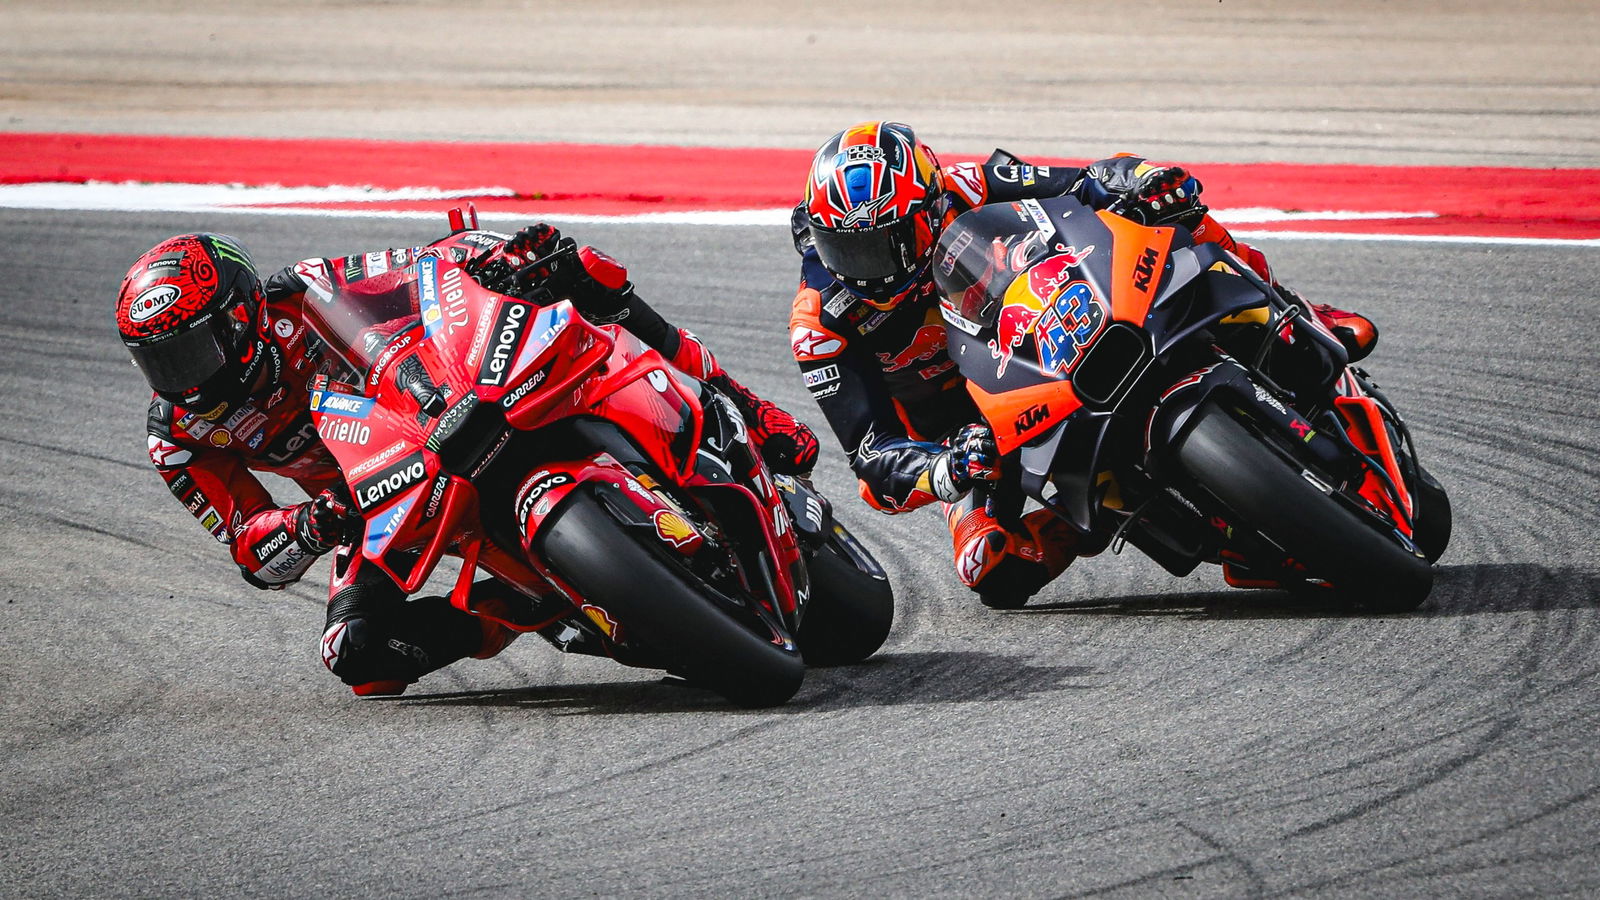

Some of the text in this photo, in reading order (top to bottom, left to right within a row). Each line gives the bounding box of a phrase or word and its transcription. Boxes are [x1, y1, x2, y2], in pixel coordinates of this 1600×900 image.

[149, 260, 177, 269] Lenovo
[884, 276, 895, 284] CAT
[1132, 248, 1159, 293] KTM
[442, 267, 467, 318] riello
[286, 325, 305, 350] motorola
[467, 296, 497, 366] FRECCIAROSSA
[481, 304, 525, 385] Lenovo
[540, 318, 567, 342] TIM
[1034, 282, 1106, 377] 43
[370, 336, 411, 386] VARGROUP
[322, 396, 363, 413] ADVANCE
[503, 370, 546, 408] CARRERA
[326, 418, 370, 446] riello
[434, 393, 477, 438] MONSTER
[1014, 404, 1050, 436] KTM
[249, 430, 264, 449] SAP
[348, 441, 406, 478] FRECCIAROSSA
[356, 462, 424, 509] Lenovo
[426, 476, 448, 518] CARRERA
[384, 506, 406, 534] TIM
[519, 476, 567, 537] Lenovo
[257, 531, 288, 561] Lenovo
